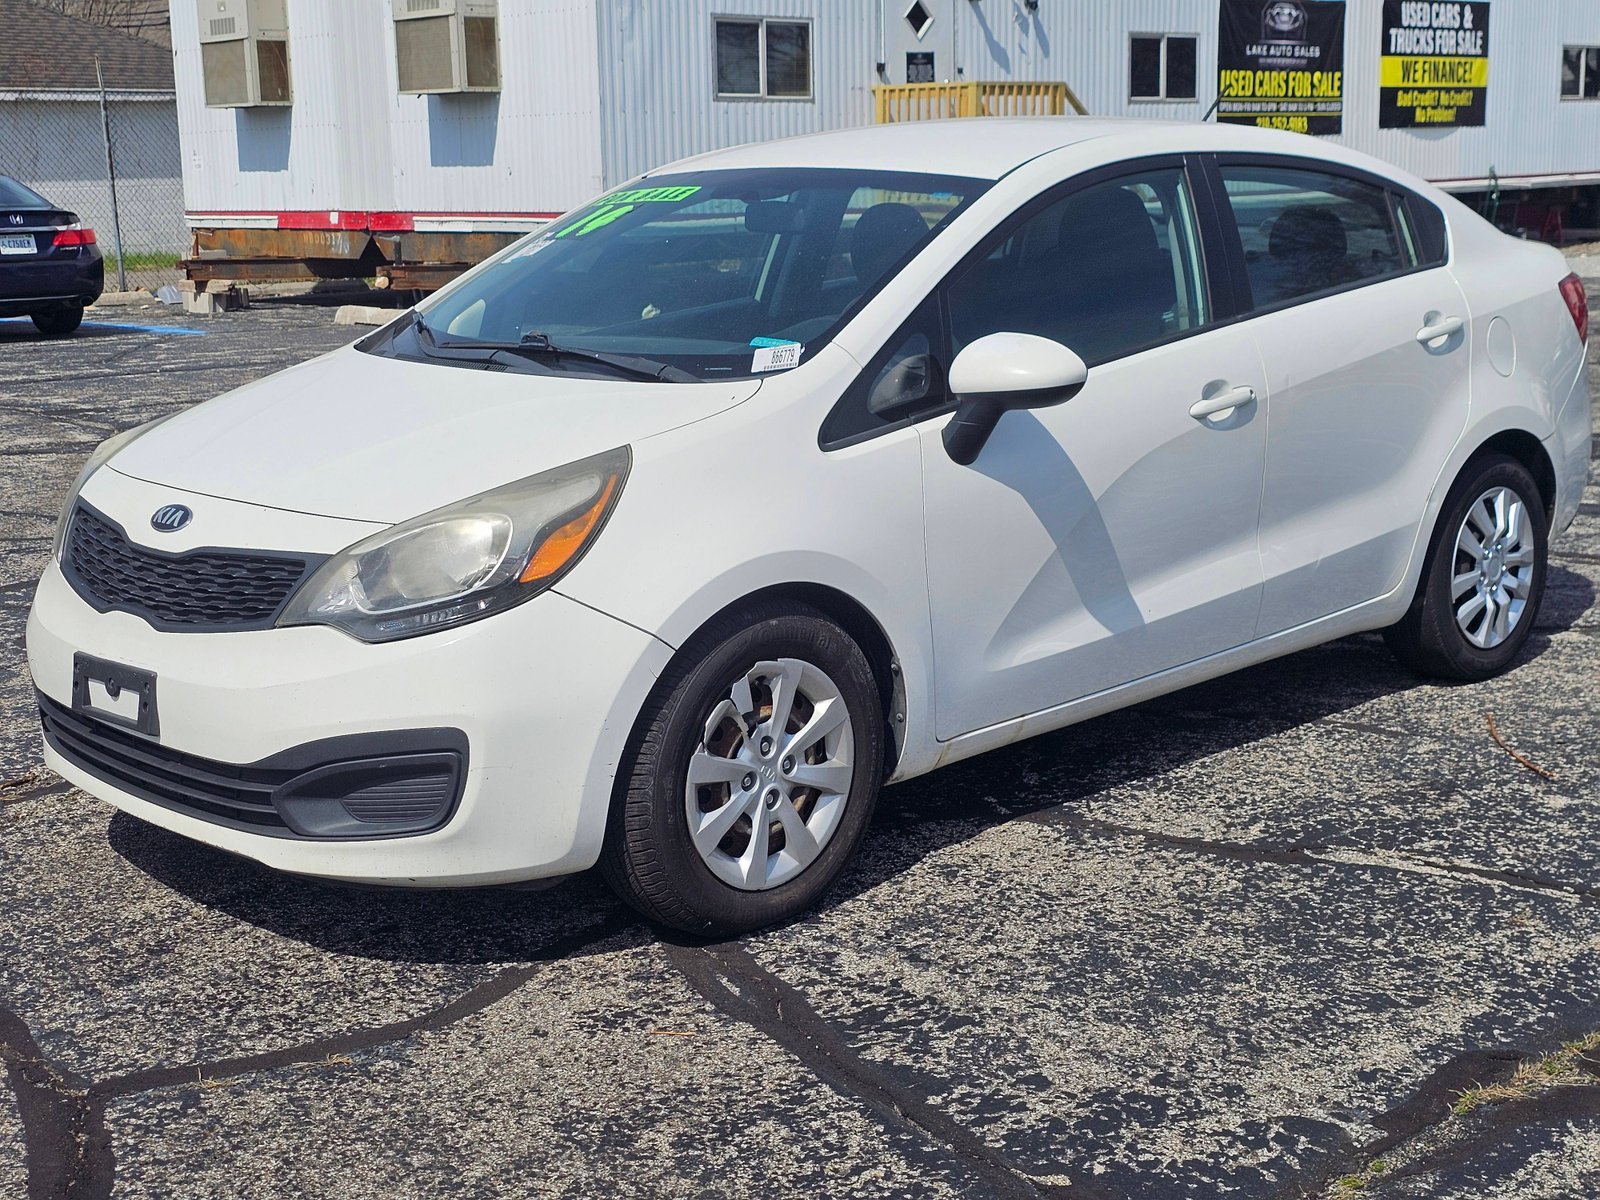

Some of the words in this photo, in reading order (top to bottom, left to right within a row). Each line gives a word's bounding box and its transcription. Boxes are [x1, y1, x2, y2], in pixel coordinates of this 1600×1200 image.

[1401, 1, 1431, 27] USED
[1431, 2, 1461, 29] CARS
[1463, 4, 1473, 29] &
[1245, 44, 1268, 56] LAKE
[1269, 45, 1292, 57] AUTO
[1294, 45, 1320, 58] SALES
[1389, 27, 1434, 54] TRUCKS
[1435, 29, 1457, 54] FOR
[1457, 30, 1484, 55] SALE
[1220, 69, 1254, 97] USED
[1255, 70, 1287, 97] CARS
[1288, 70, 1312, 97] FOR
[1313, 71, 1342, 97] SALE
[1402, 60, 1419, 82] WE
[1422, 60, 1473, 83] FINANCE!
[770, 348, 796, 365] 866779
[153, 506, 185, 528] KIA
